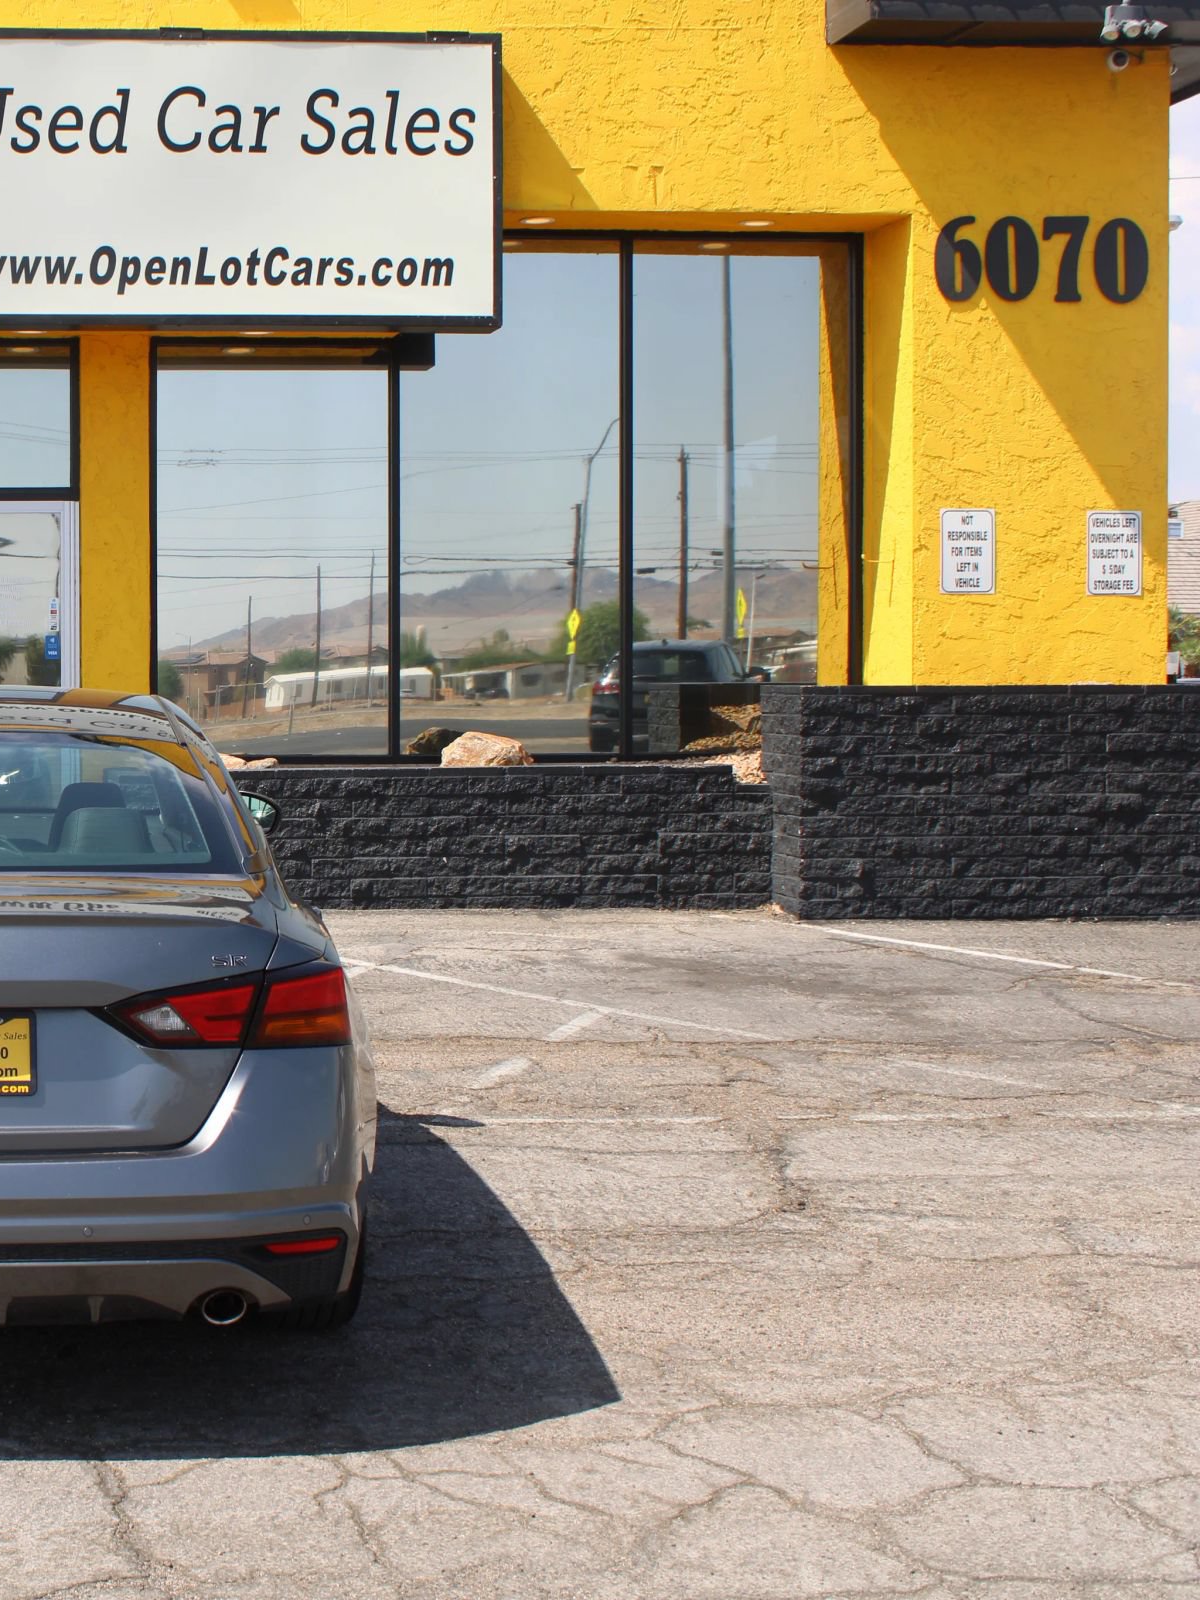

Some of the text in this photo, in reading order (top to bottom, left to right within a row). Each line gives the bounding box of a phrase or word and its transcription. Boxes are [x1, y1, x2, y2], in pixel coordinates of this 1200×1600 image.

[157, 86, 281, 153] Car
[301, 88, 477, 156] Sales
[934, 215, 1149, 304] 6070
[961, 516, 974, 526] NOT
[1091, 518, 1136, 528] VEHICLES LEFT
[947, 531, 988, 541] RESPONSIBLE
[1090, 533, 1138, 544] OVERNIGHT ARE
[951, 547, 982, 557] FOR ITEMS
[1092, 549, 1134, 559] SUBJECT TO A
[956, 562, 979, 573] LEFT IN
[955, 578, 981, 588] VEHICLE
[1093, 580, 1134, 590] STORAGE FEE
[211, 954, 248, 968] SR
[3, 1032, 28, 1041] Sales
